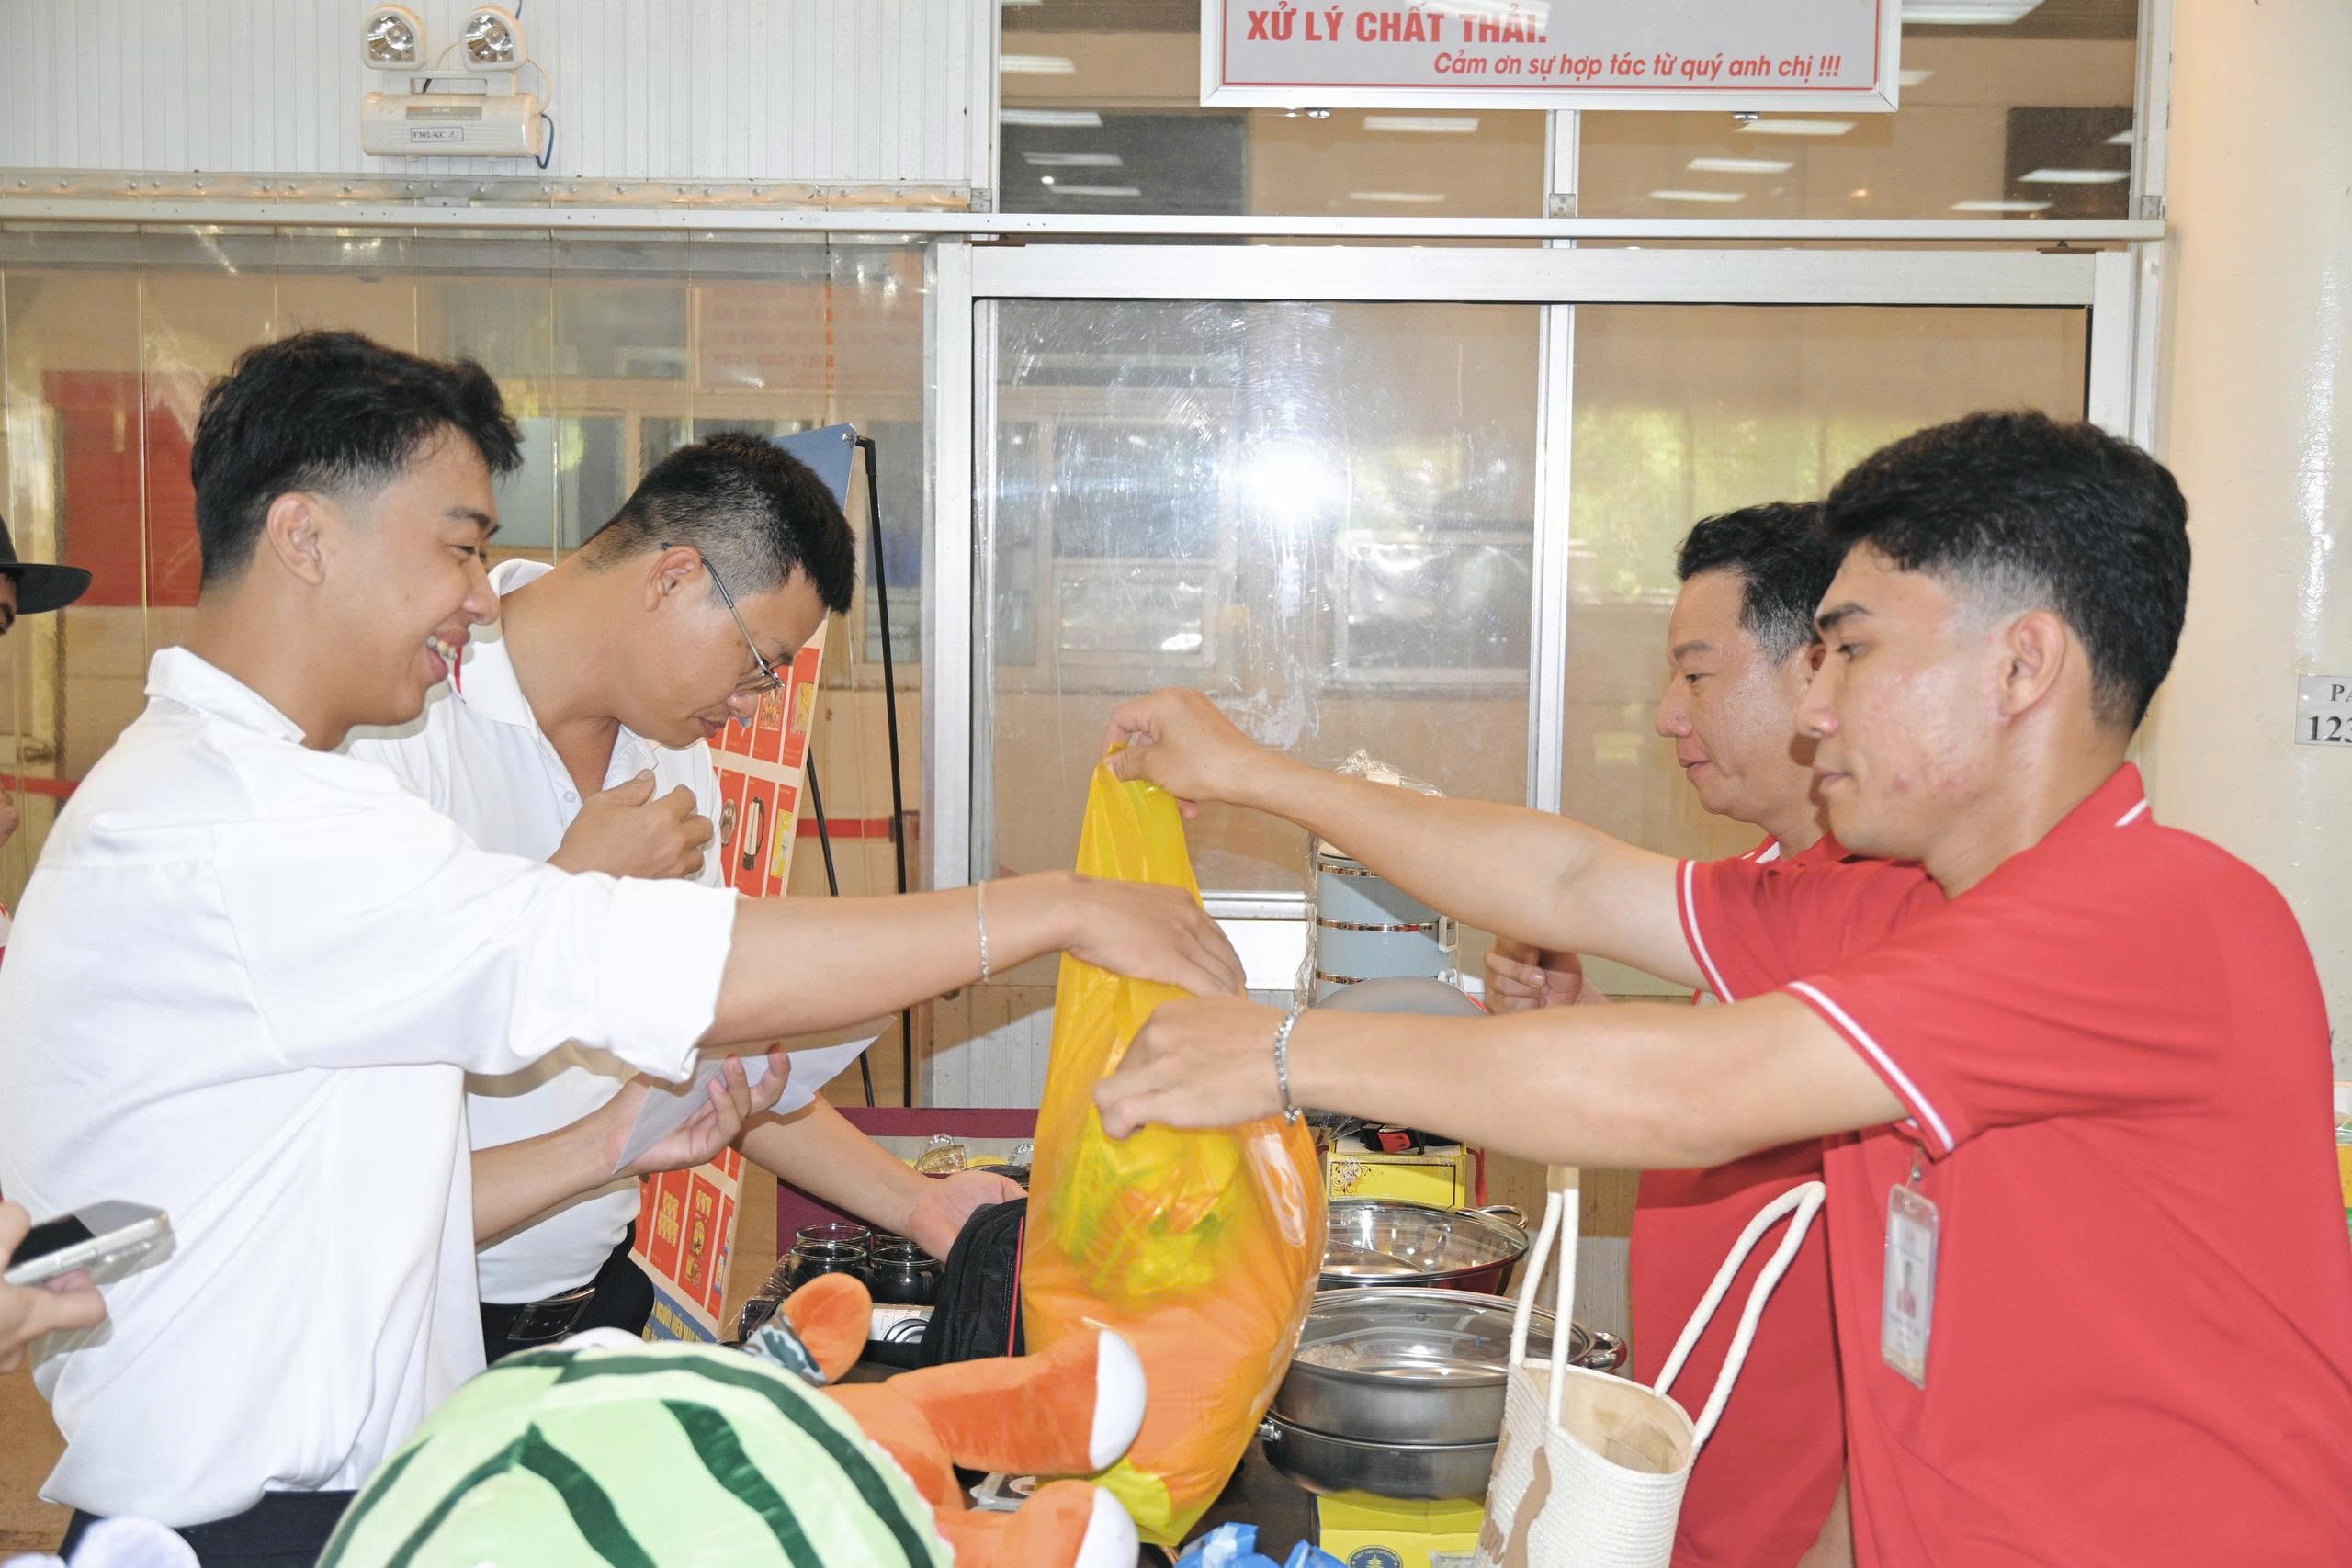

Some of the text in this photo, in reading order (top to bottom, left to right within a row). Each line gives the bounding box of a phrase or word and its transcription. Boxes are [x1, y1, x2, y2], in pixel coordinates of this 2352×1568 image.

[1247, 0, 1297, 41] XỬ
[1305, 5, 1344, 42] LÝ
[1433, 49, 1842, 84] Cảm ơn sự hợp tác từ quý anh chị !!!
